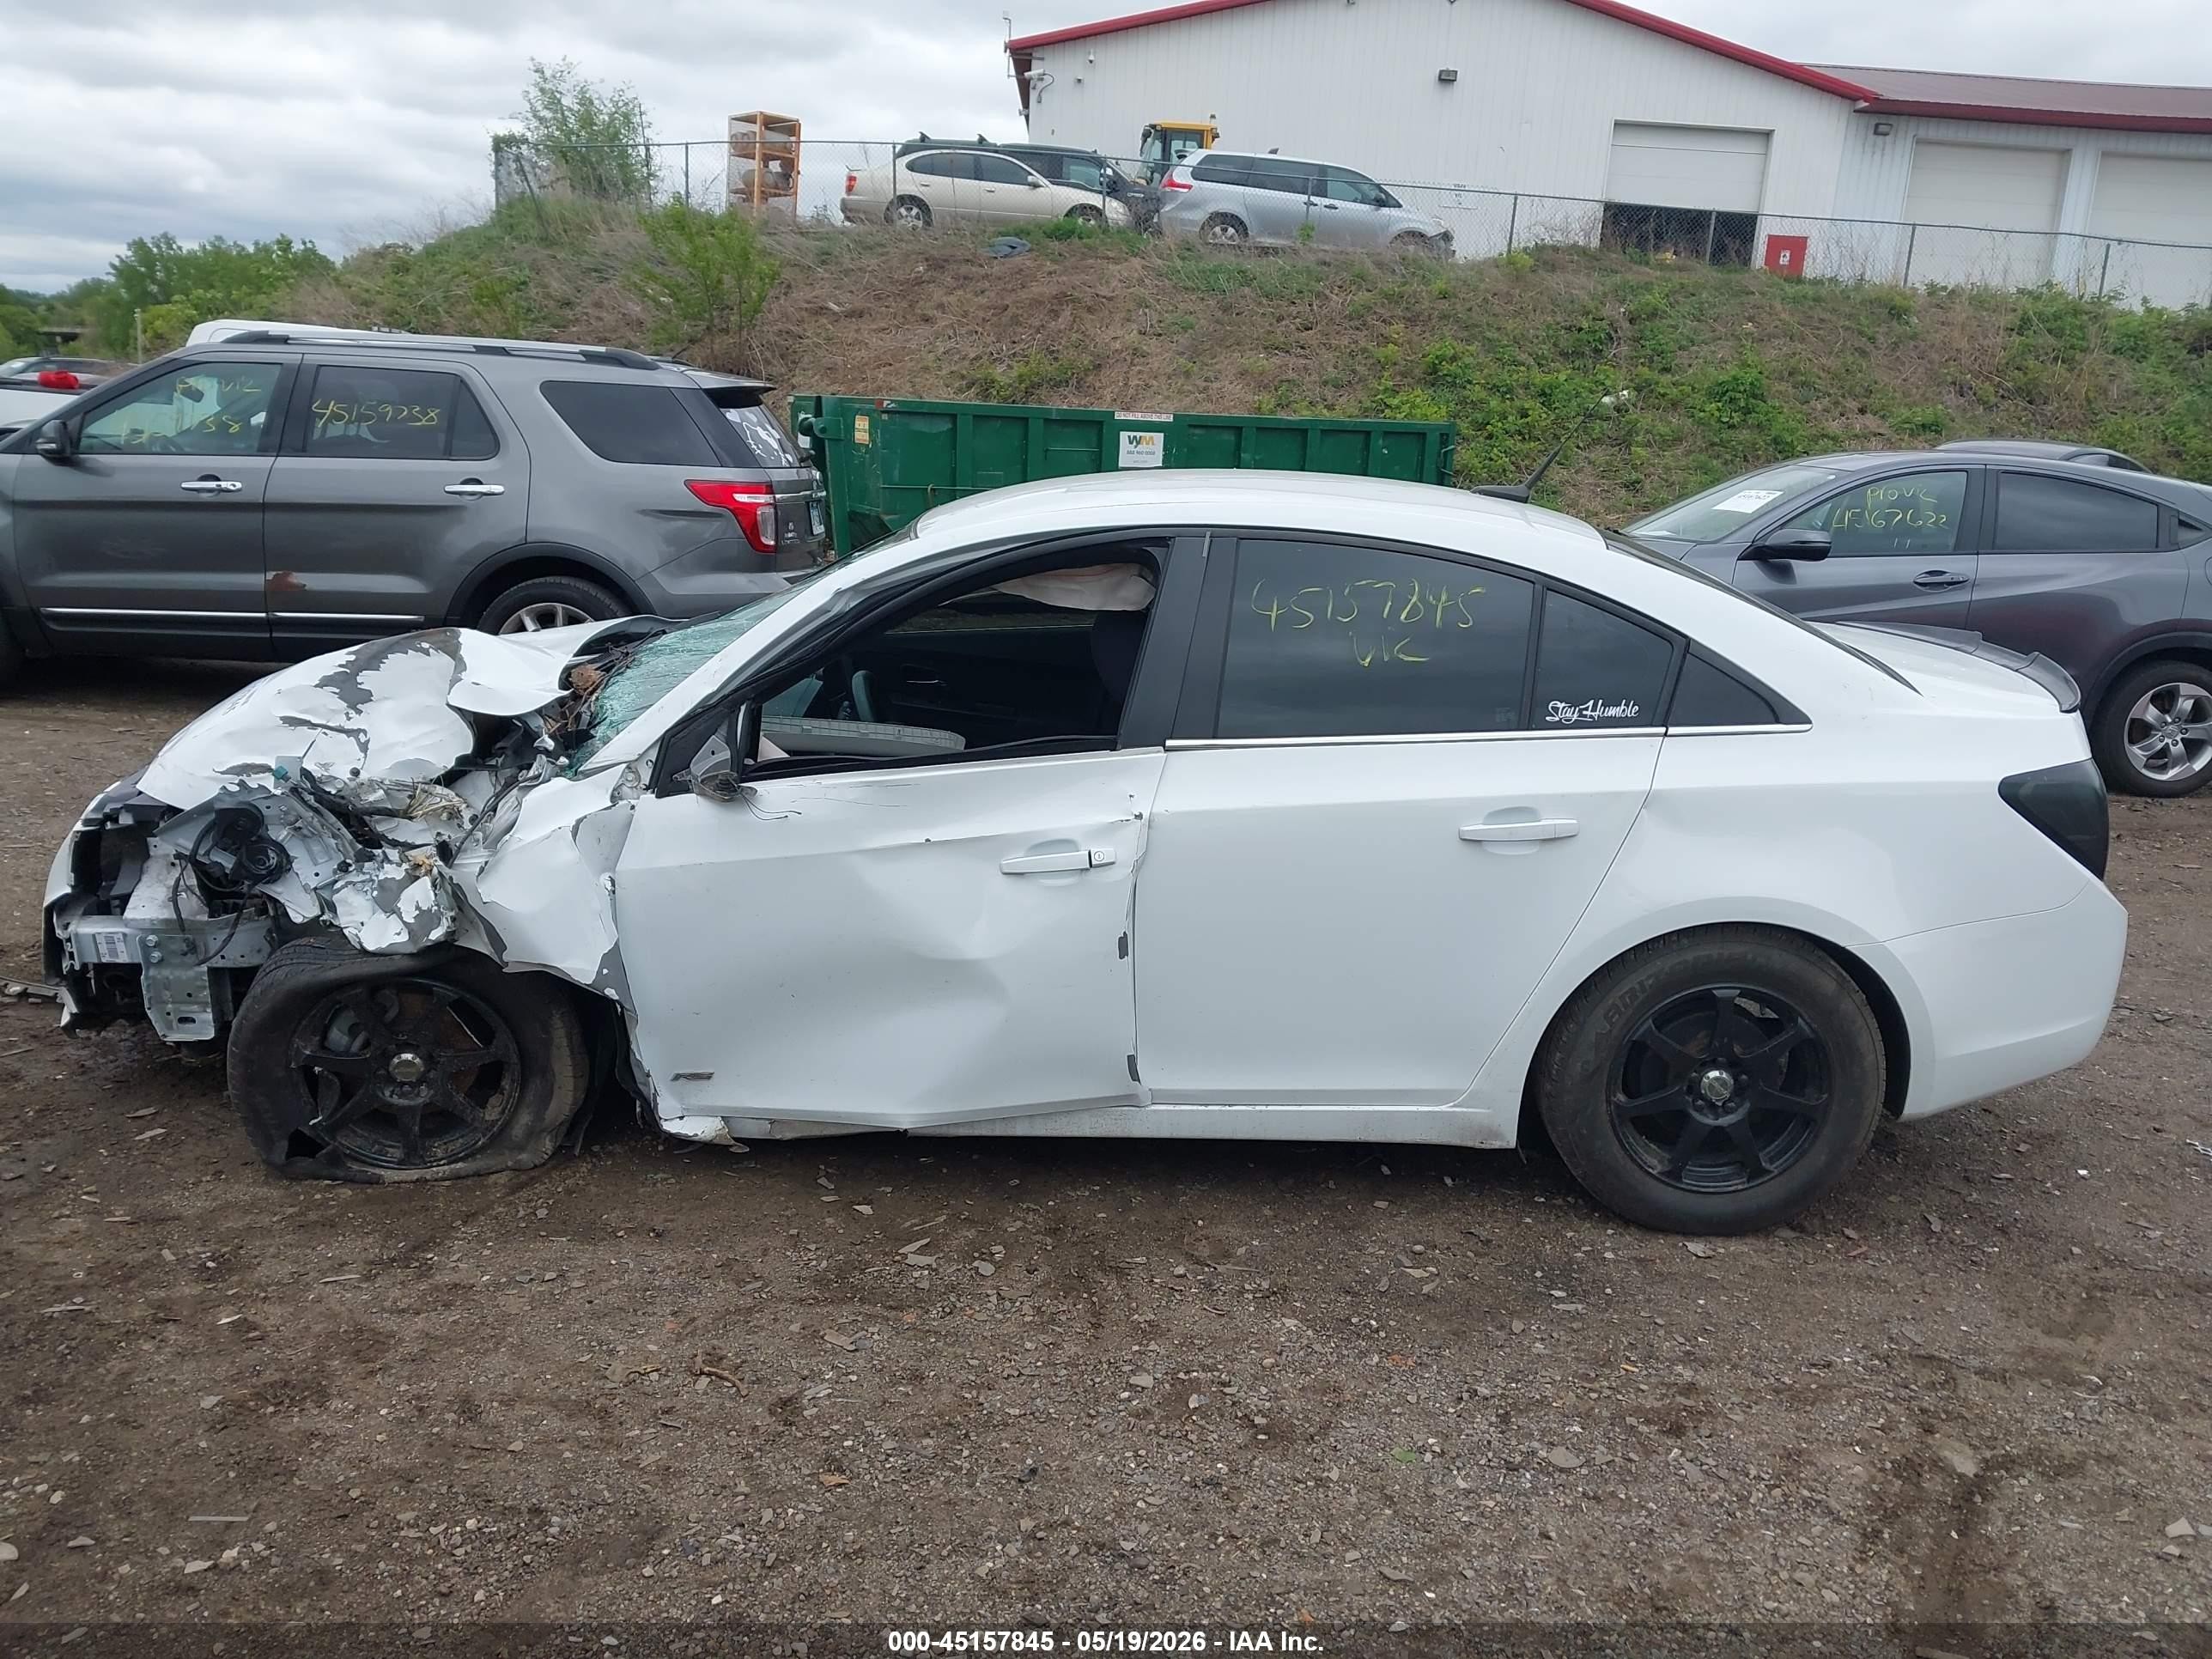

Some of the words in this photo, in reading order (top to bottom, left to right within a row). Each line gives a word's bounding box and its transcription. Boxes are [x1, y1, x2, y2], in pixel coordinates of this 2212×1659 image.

[311, 398, 441, 428] 45159738
[1832, 507, 1949, 532] 45167622
[1251, 578, 1486, 632] 45157845
[1545, 700, 1589, 725] Stay
[1578, 699, 1639, 721] Humble
